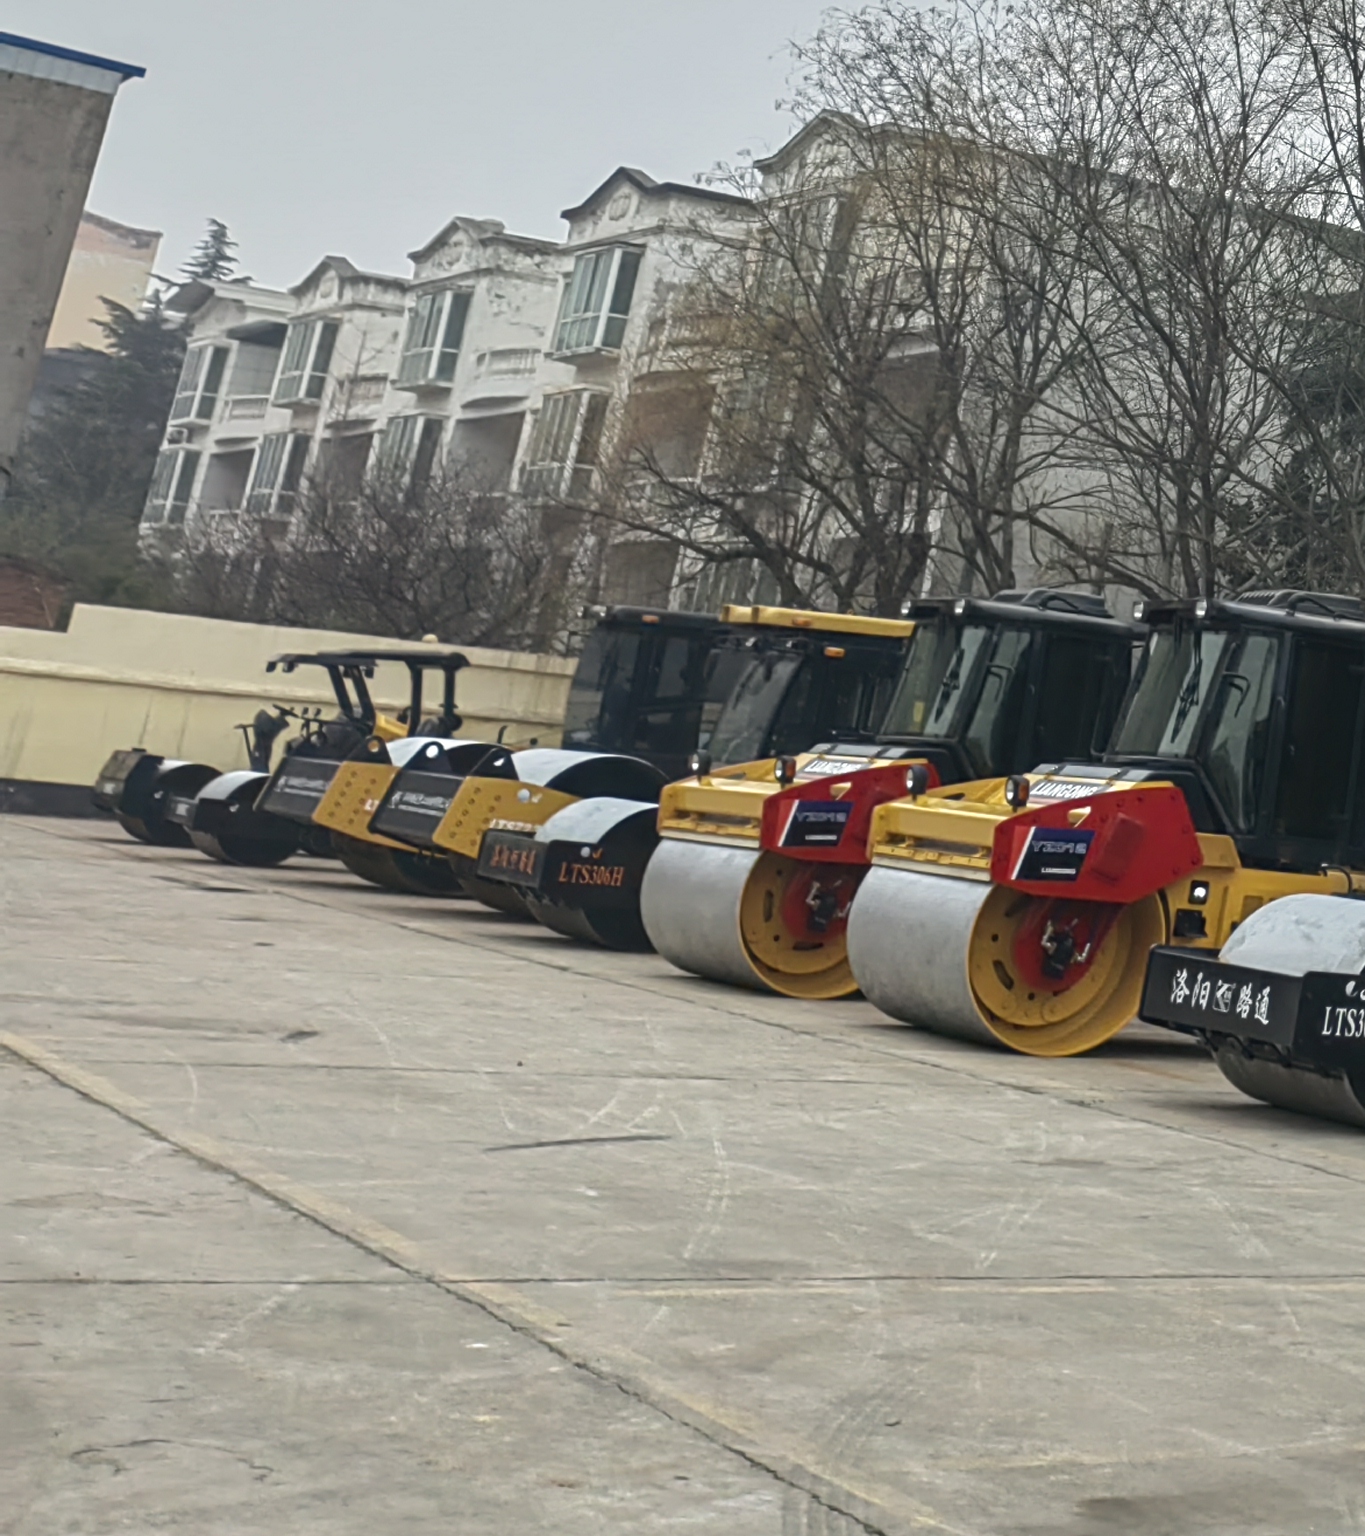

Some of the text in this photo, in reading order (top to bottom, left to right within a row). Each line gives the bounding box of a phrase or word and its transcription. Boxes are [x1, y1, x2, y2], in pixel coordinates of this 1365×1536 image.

[558, 861, 625, 887] LTS306H
[1170, 968, 1272, 1025] 洛阳 路通
